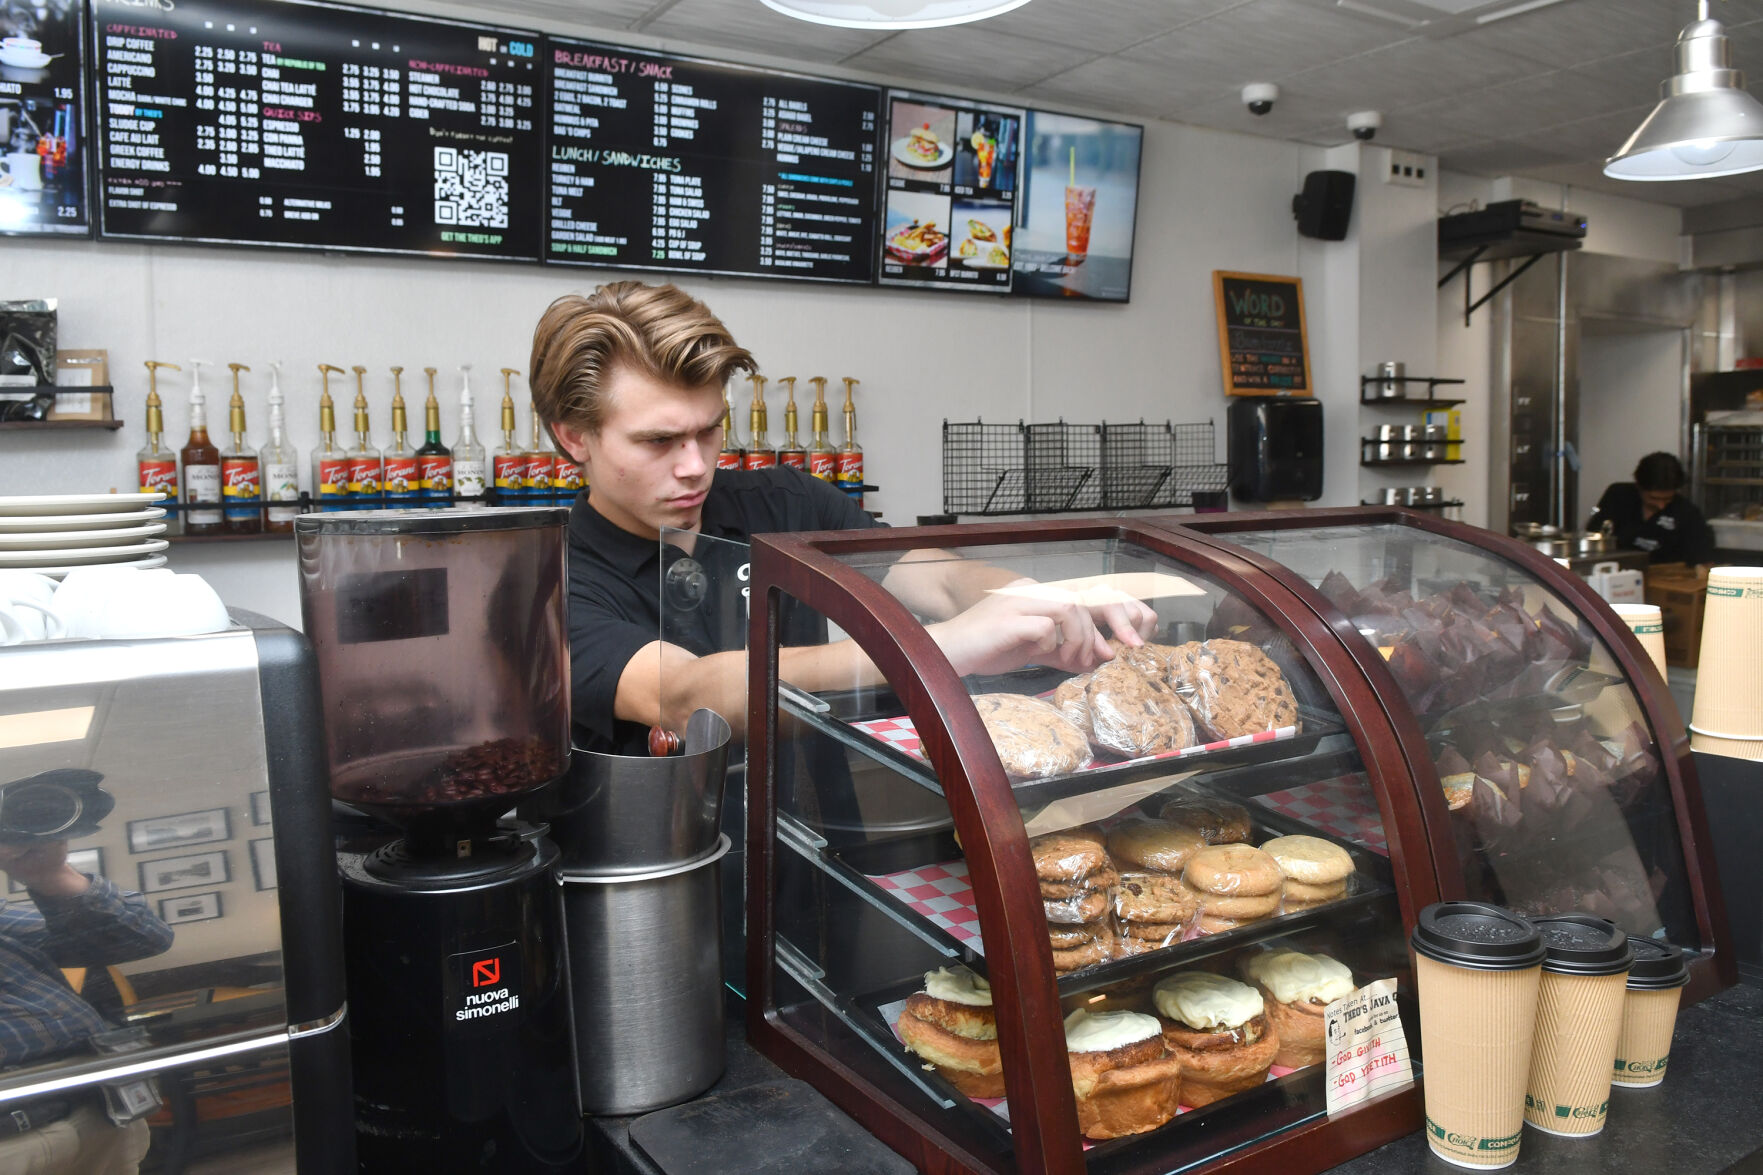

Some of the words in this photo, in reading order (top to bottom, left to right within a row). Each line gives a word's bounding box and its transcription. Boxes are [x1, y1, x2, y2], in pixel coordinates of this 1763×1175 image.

[126, 38, 155, 52] COFFEE
[263, 41, 281, 53] TEA
[509, 41, 533, 58] COLD
[107, 49, 152, 64] AMERICANO
[554, 50, 628, 73] BREAKFAST
[638, 63, 673, 79] SNACK
[107, 62, 156, 78] CAPPUCCINO
[54, 88, 73, 99] 1.95
[602, 150, 681, 172] SANDWICHES
[57, 207, 77, 217] 2.25
[1230, 288, 1286, 318] WORD
[384, 464, 416, 481] Torani
[422, 463, 452, 481] Toran
[466, 988, 509, 1006] nuova
[456, 995, 519, 1021] simonelli
[1327, 1008, 1342, 1019] Notes
[1343, 1004, 1368, 1023] THEO'S
[1370, 996, 1390, 1010] JAVA
